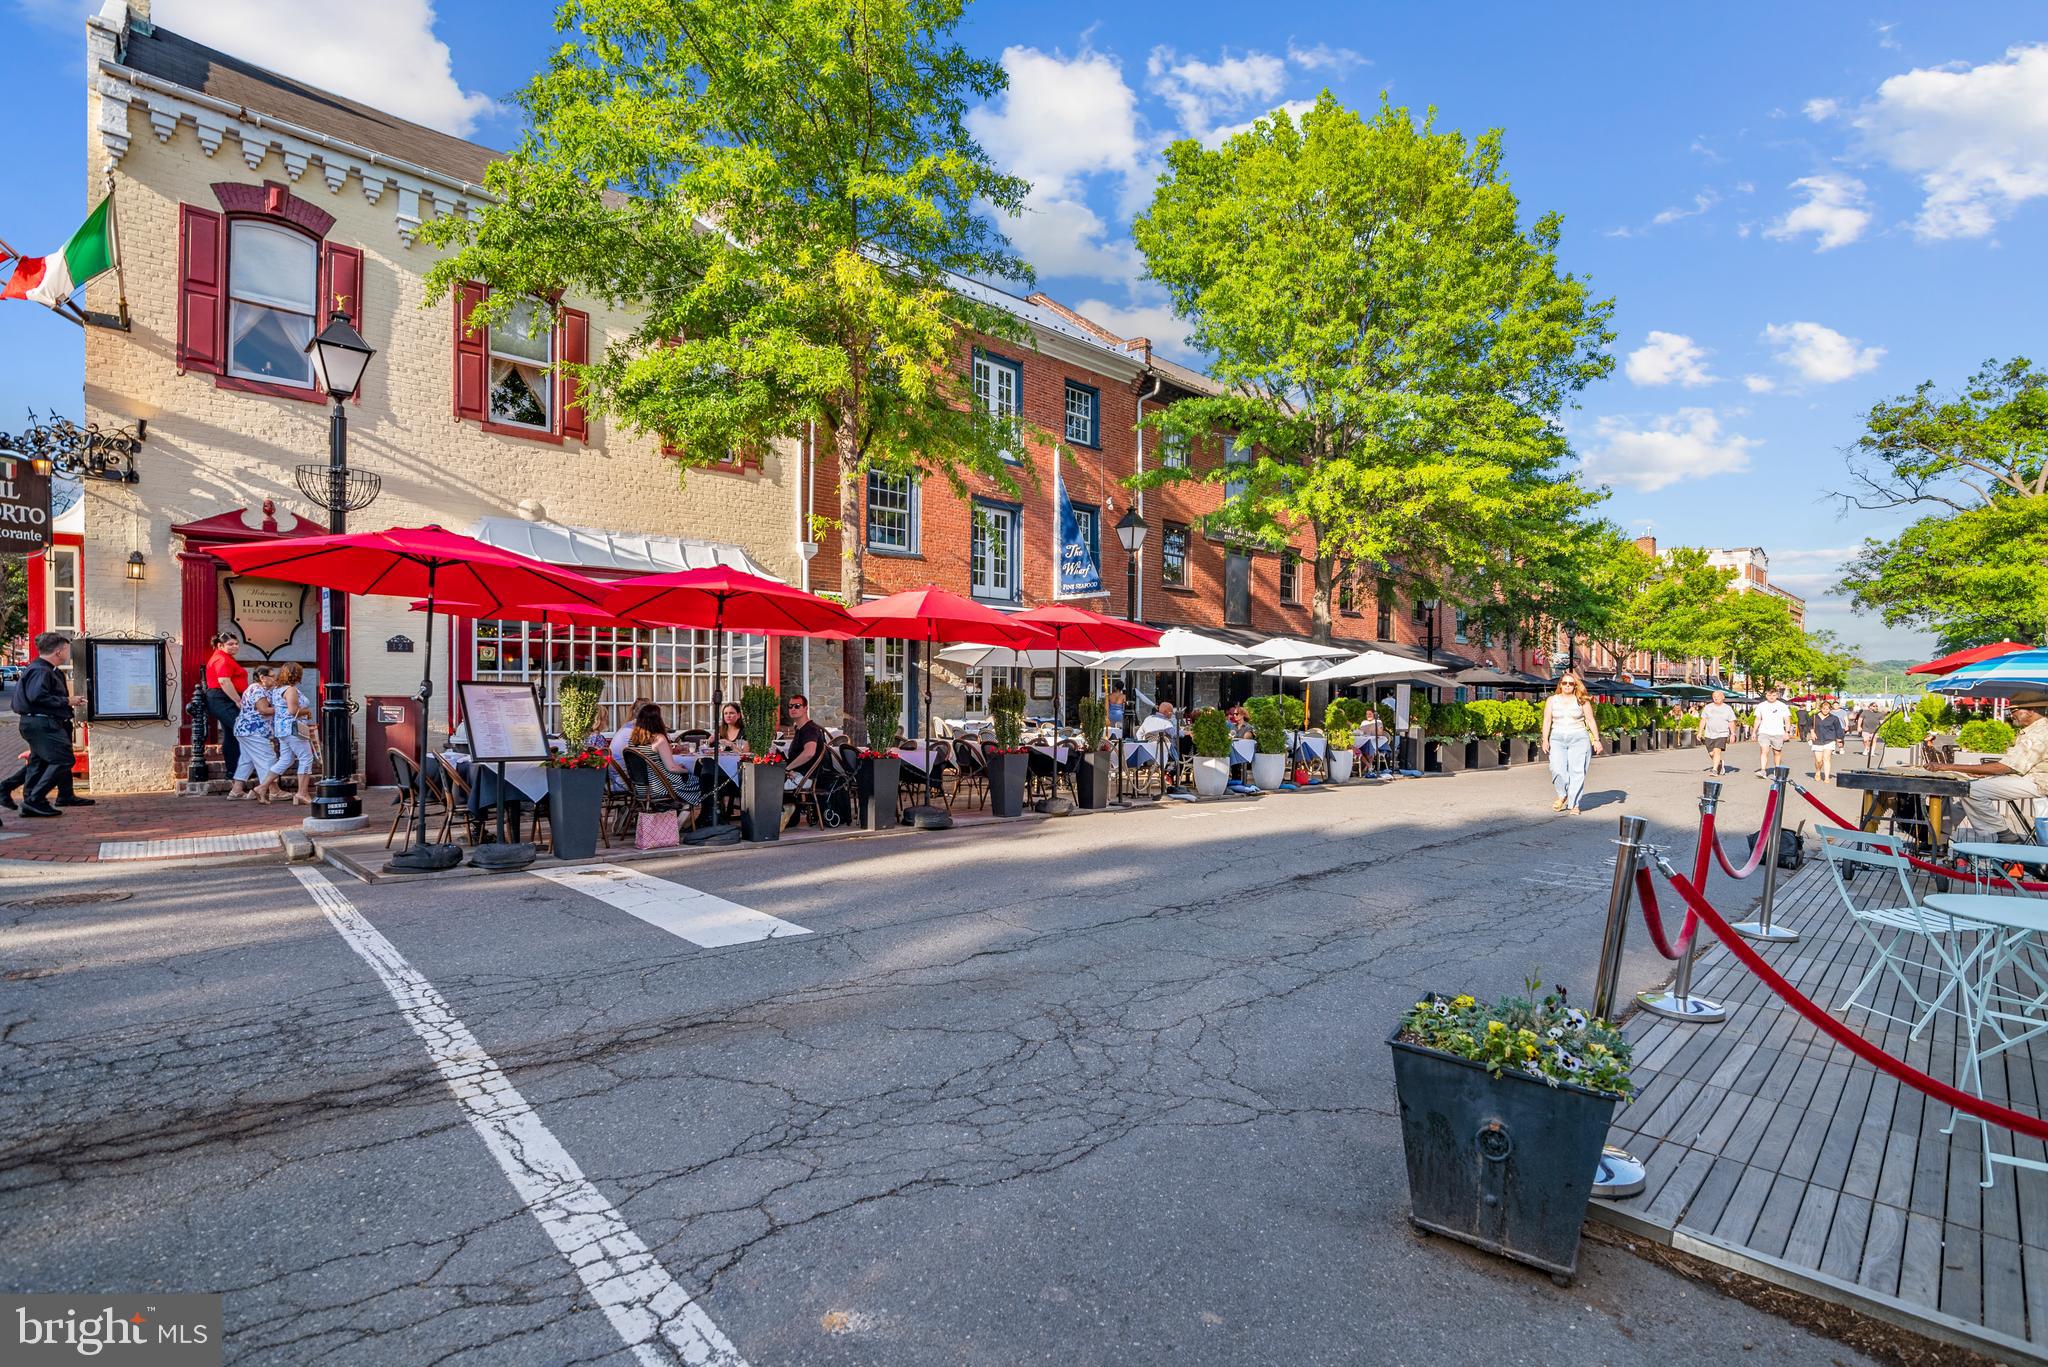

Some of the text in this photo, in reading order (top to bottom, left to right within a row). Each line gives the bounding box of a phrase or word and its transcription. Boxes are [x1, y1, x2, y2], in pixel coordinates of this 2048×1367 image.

[0, 502, 46, 525] RTO
[0, 527, 42, 542] orante
[1065, 544, 1083, 558] The
[1062, 561, 1091, 577] Wharf
[242, 599, 293, 608] IL PORTO
